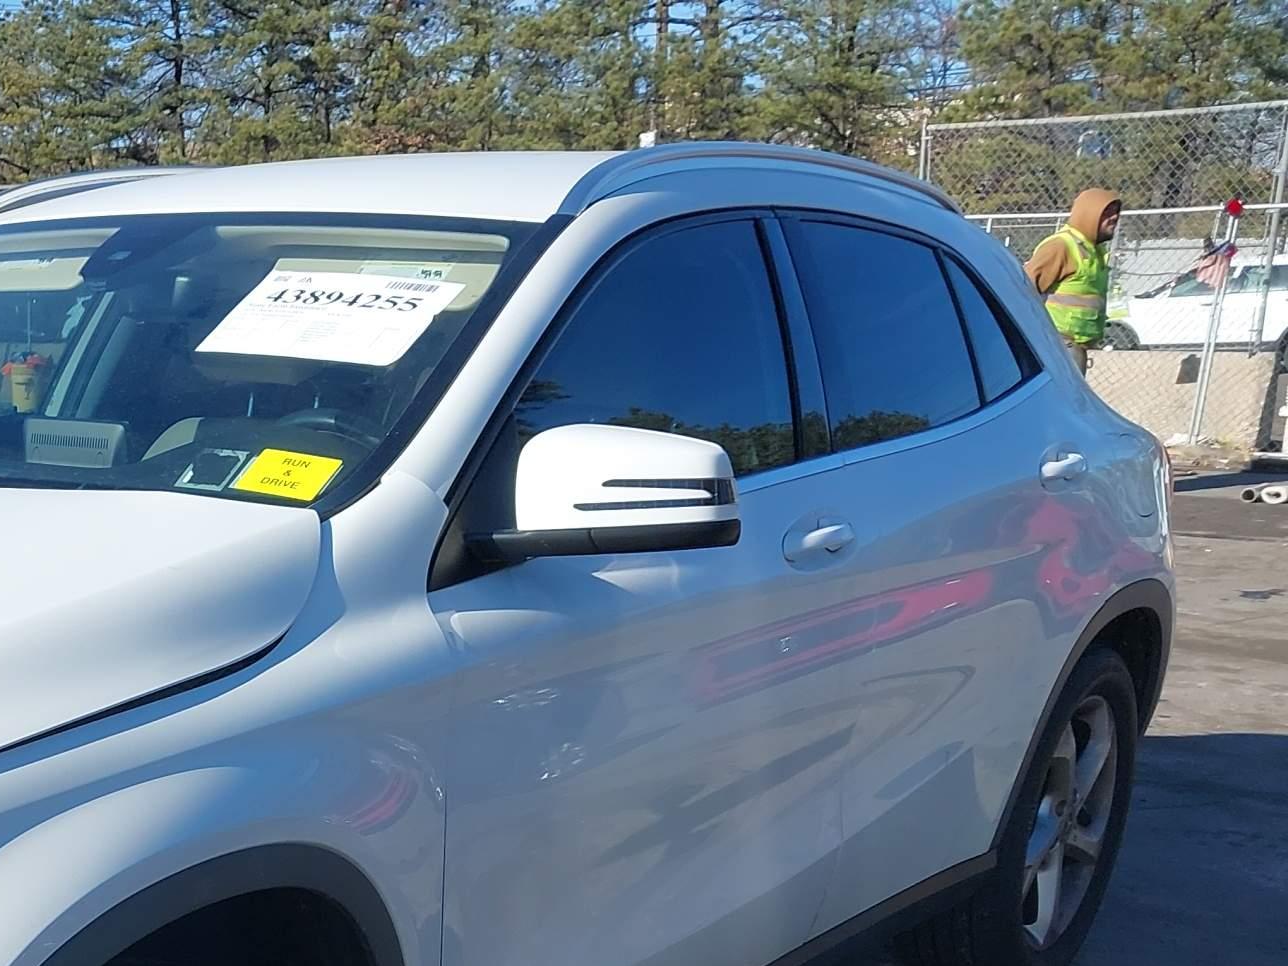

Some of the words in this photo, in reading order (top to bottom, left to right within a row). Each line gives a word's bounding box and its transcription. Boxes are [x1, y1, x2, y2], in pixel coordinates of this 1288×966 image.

[266, 288, 424, 312] 43894255
[282, 458, 311, 468] RUN
[259, 477, 300, 489] DRIVE
